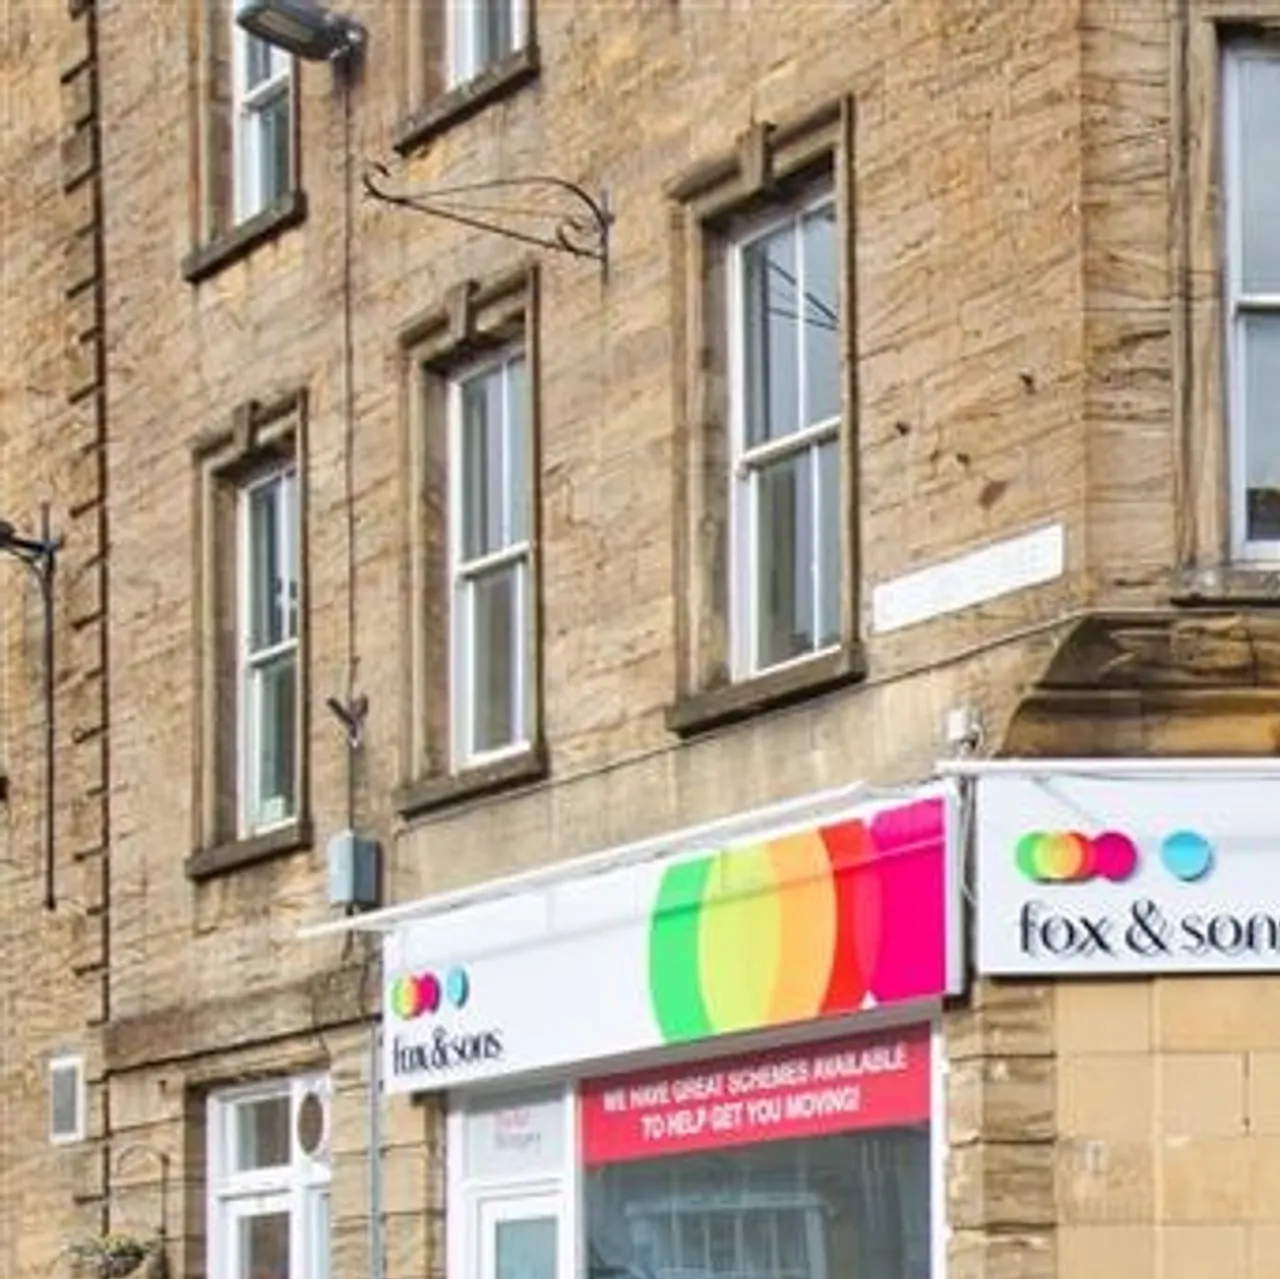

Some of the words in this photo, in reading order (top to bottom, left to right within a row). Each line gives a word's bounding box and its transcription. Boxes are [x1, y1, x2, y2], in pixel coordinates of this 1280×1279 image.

[1020, 900, 1114, 953] fox
[1124, 899, 1170, 954] &
[671, 1074, 724, 1101] GREAT
[728, 1061, 808, 1095] SCHEMES
[812, 1044, 907, 1079] AVAILABLE
[641, 1116, 664, 1140] TO
[667, 1110, 705, 1138] HELP
[710, 1103, 743, 1131] GET
[747, 1099, 783, 1125] YOU
